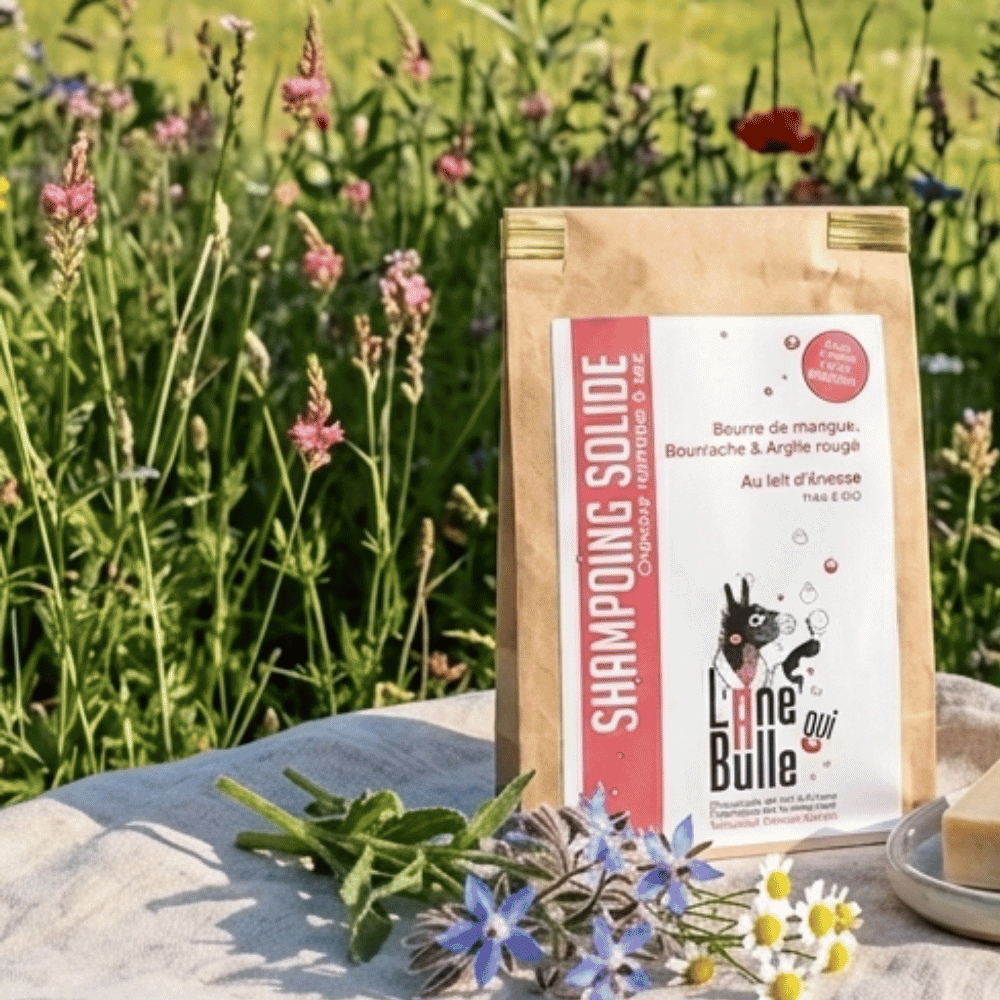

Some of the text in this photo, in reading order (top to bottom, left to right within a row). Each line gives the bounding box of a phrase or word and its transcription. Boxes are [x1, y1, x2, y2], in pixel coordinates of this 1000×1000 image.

[768, 420, 789, 434] de
[740, 474, 763, 489] Au
[582, 355, 639, 733] SHAMPOING SOLIDE
[709, 729, 797, 792] Bulle
